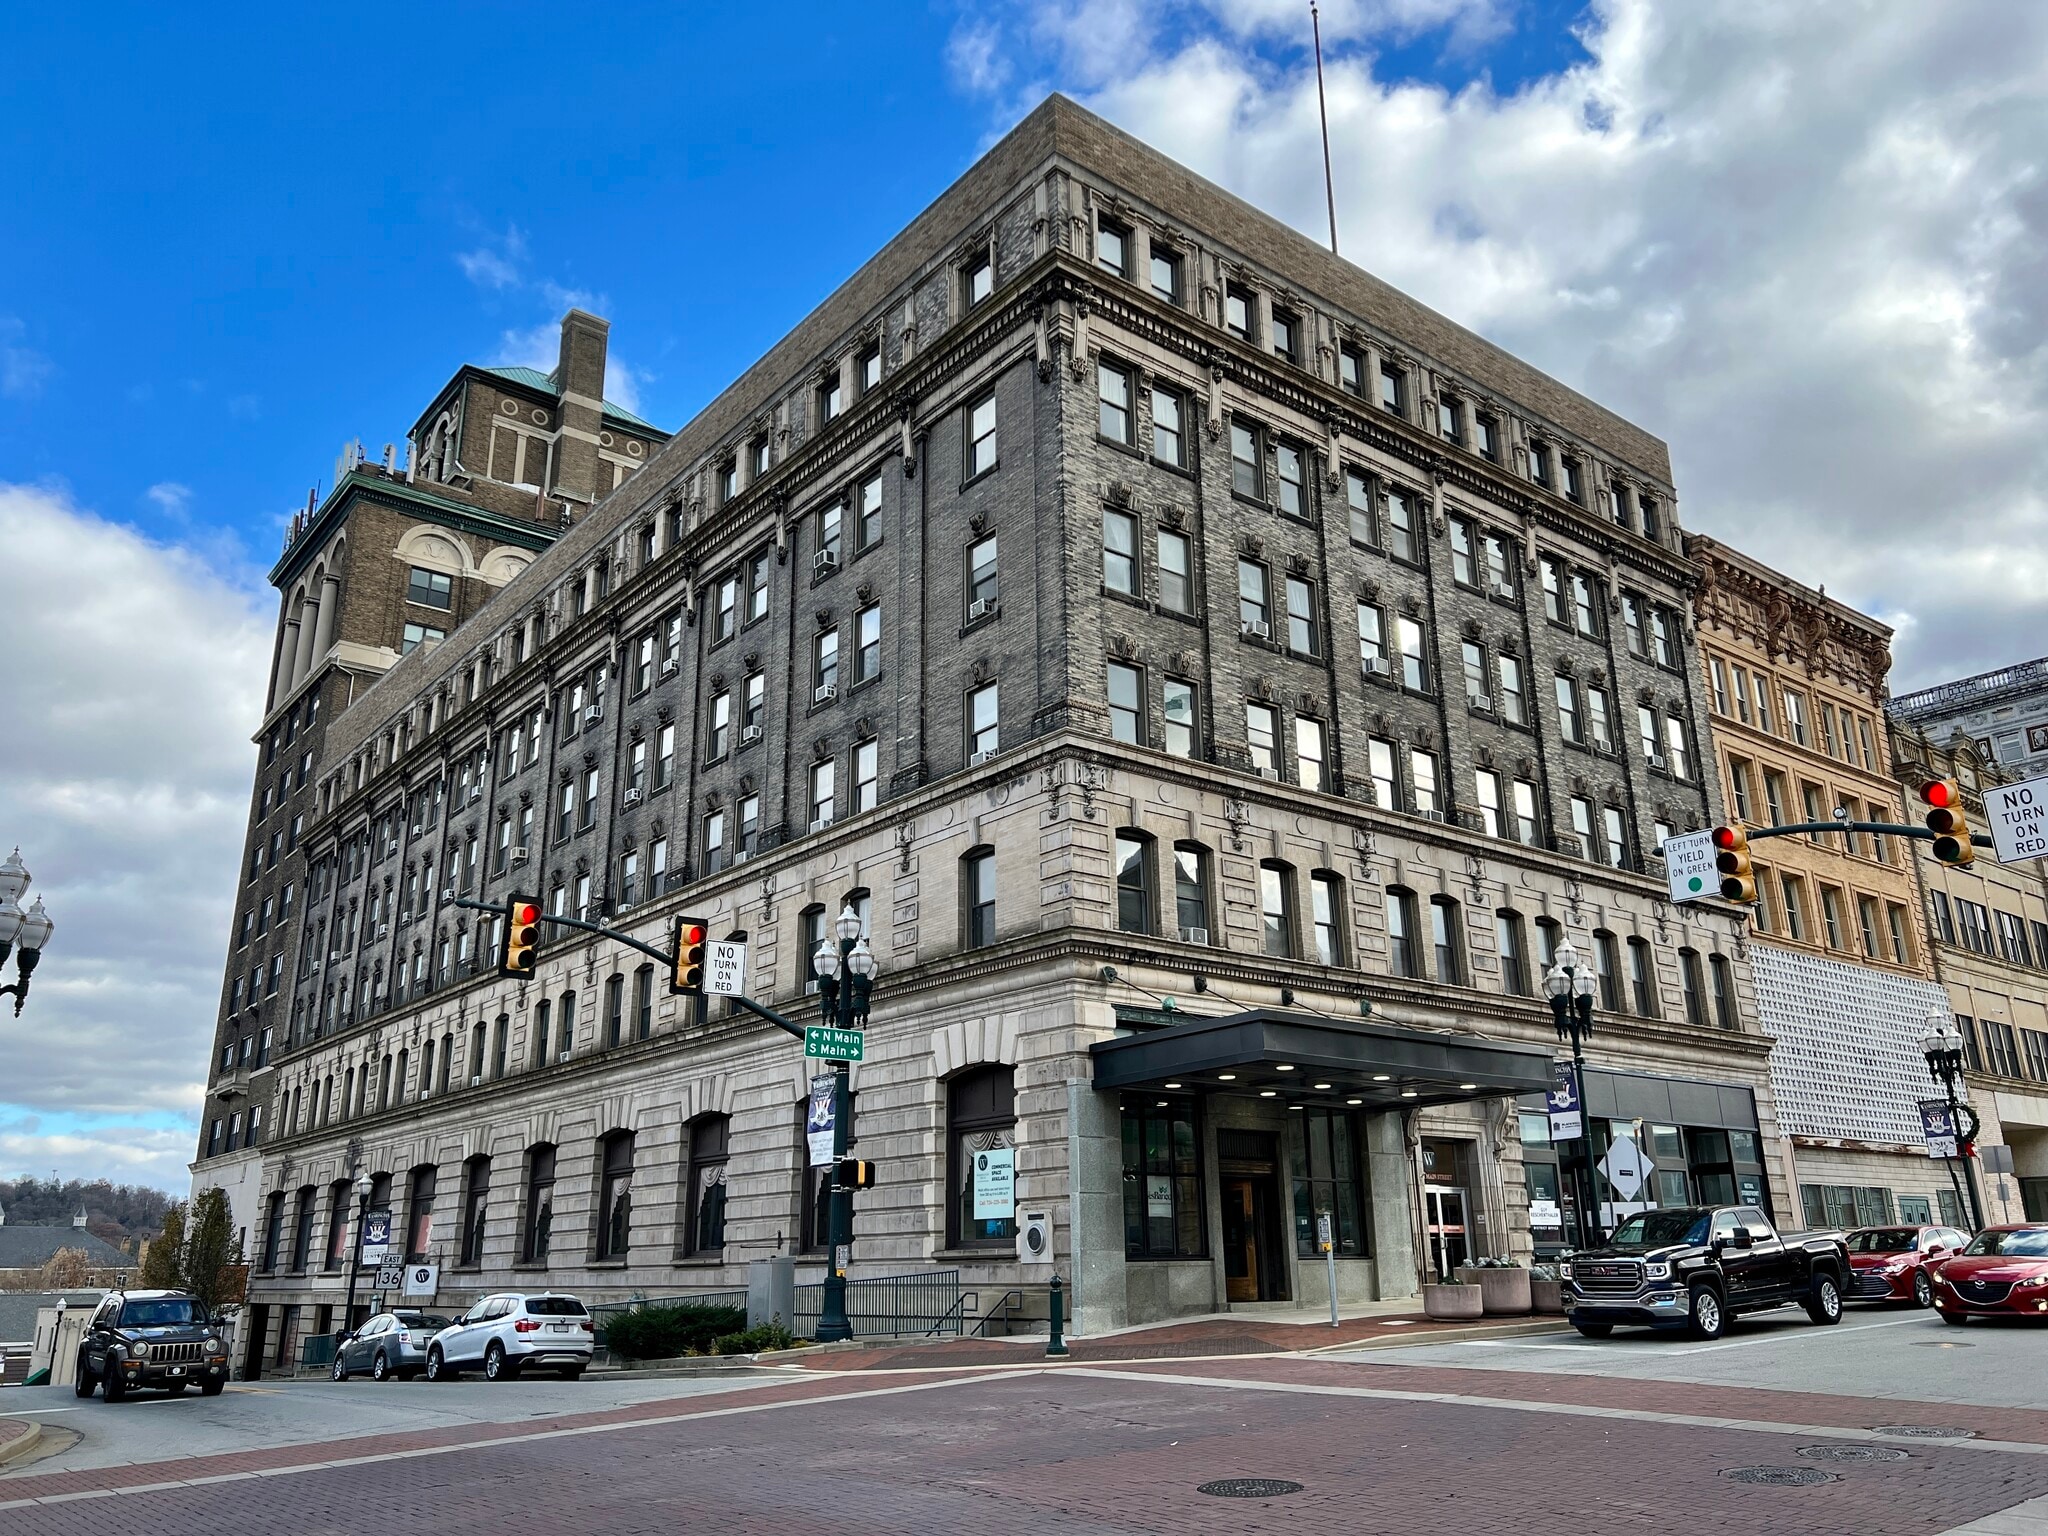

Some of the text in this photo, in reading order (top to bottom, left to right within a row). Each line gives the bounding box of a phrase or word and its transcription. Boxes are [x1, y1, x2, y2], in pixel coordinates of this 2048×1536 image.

[2003, 789, 2032, 809] NO
[2002, 806, 2044, 824] TURN
[2016, 823, 2038, 837] ON
[1668, 836, 1710, 852] LEFT TURN
[2015, 838, 2046, 854] RED
[1678, 850, 1704, 864] YIELD
[1673, 862, 1713, 877] ON GREEN
[718, 946, 734, 958] NO
[714, 960, 737, 970] TURN
[718, 971, 731, 980] ON
[715, 981, 732, 991] RED
[823, 1031, 860, 1044] N Main
[810, 1043, 847, 1056] S Main
[384, 1255, 400, 1263] EAST
[377, 1272, 399, 1284] 136
